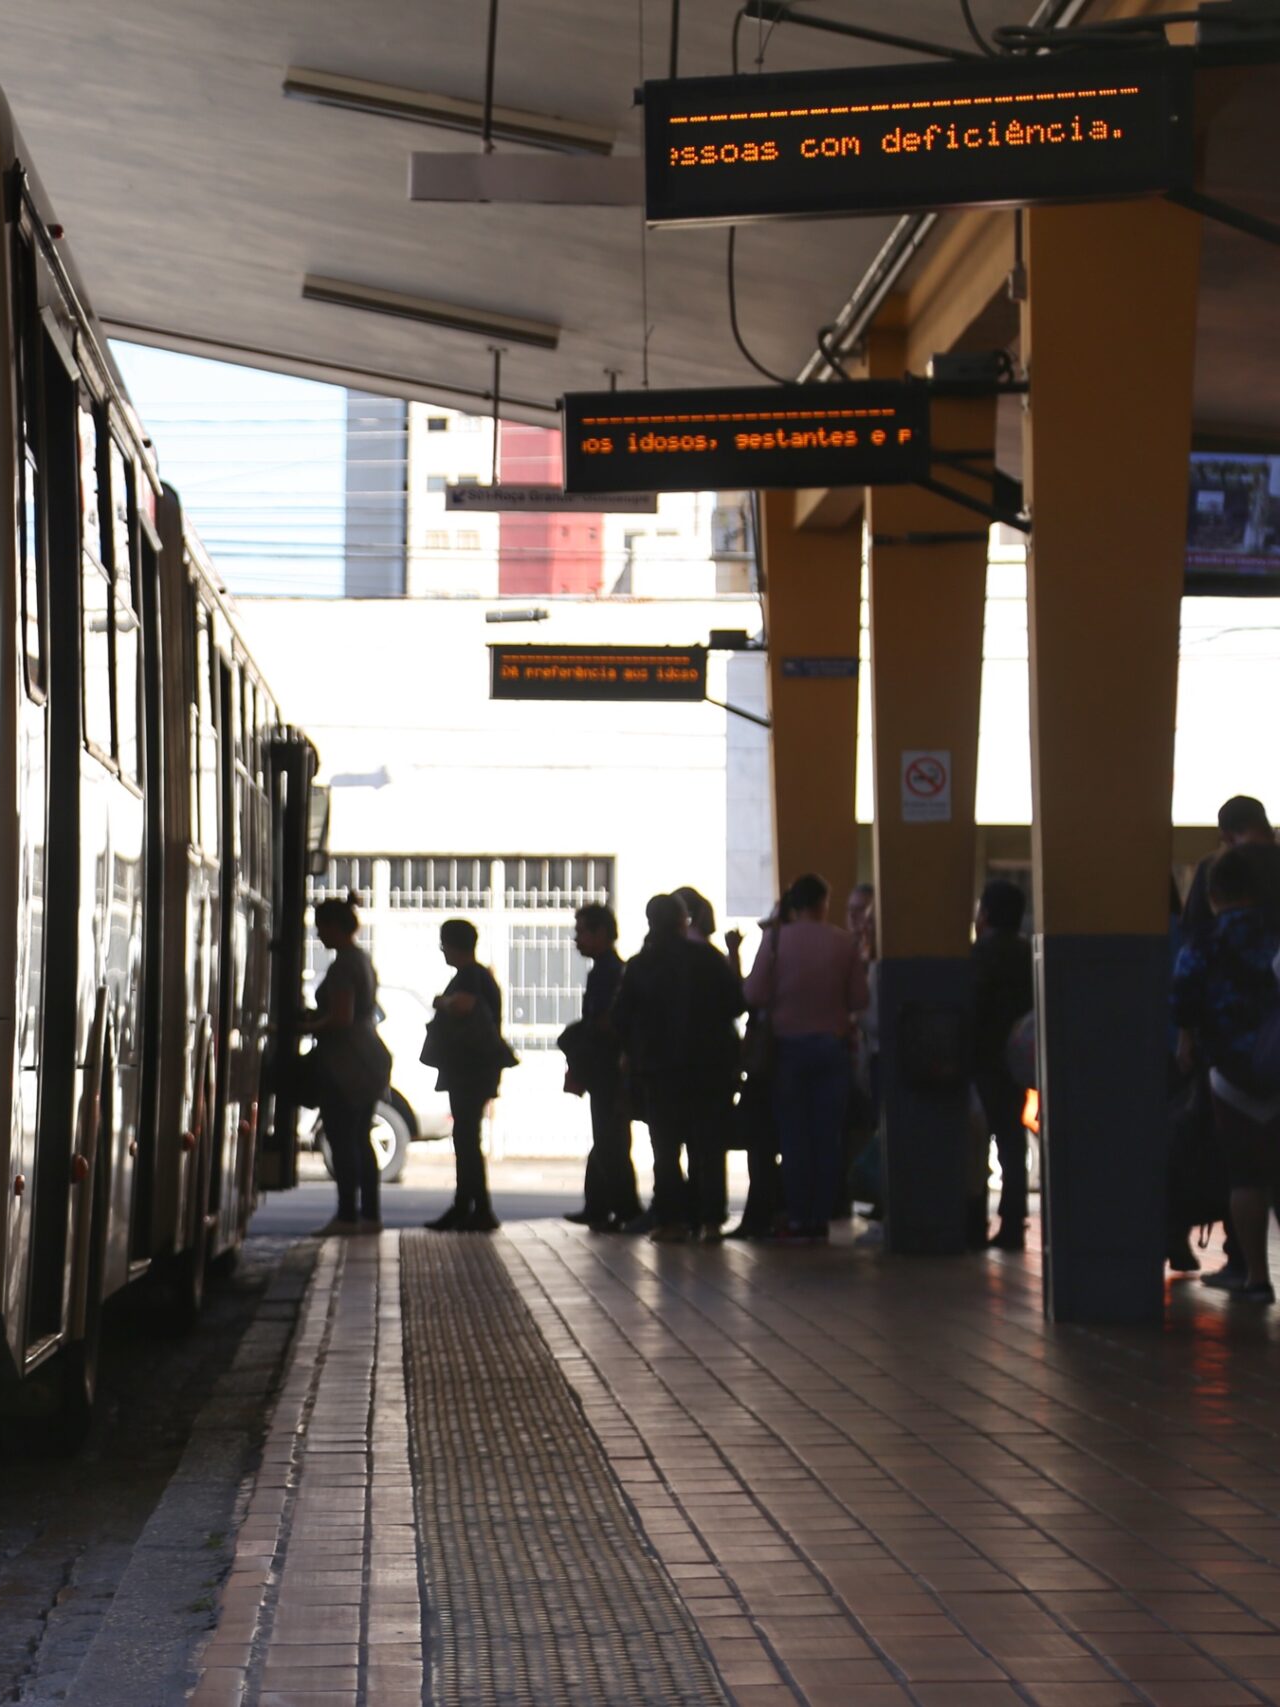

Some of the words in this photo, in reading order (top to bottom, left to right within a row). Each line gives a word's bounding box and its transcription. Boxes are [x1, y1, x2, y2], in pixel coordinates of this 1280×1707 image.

[800, 135, 861, 159] com
[881, 115, 1123, 154] deficiência.
[581, 437, 614, 454] os
[628, 431, 720, 454] idosos,
[734, 426, 859, 450] gestantes
[871, 428, 887, 446] e
